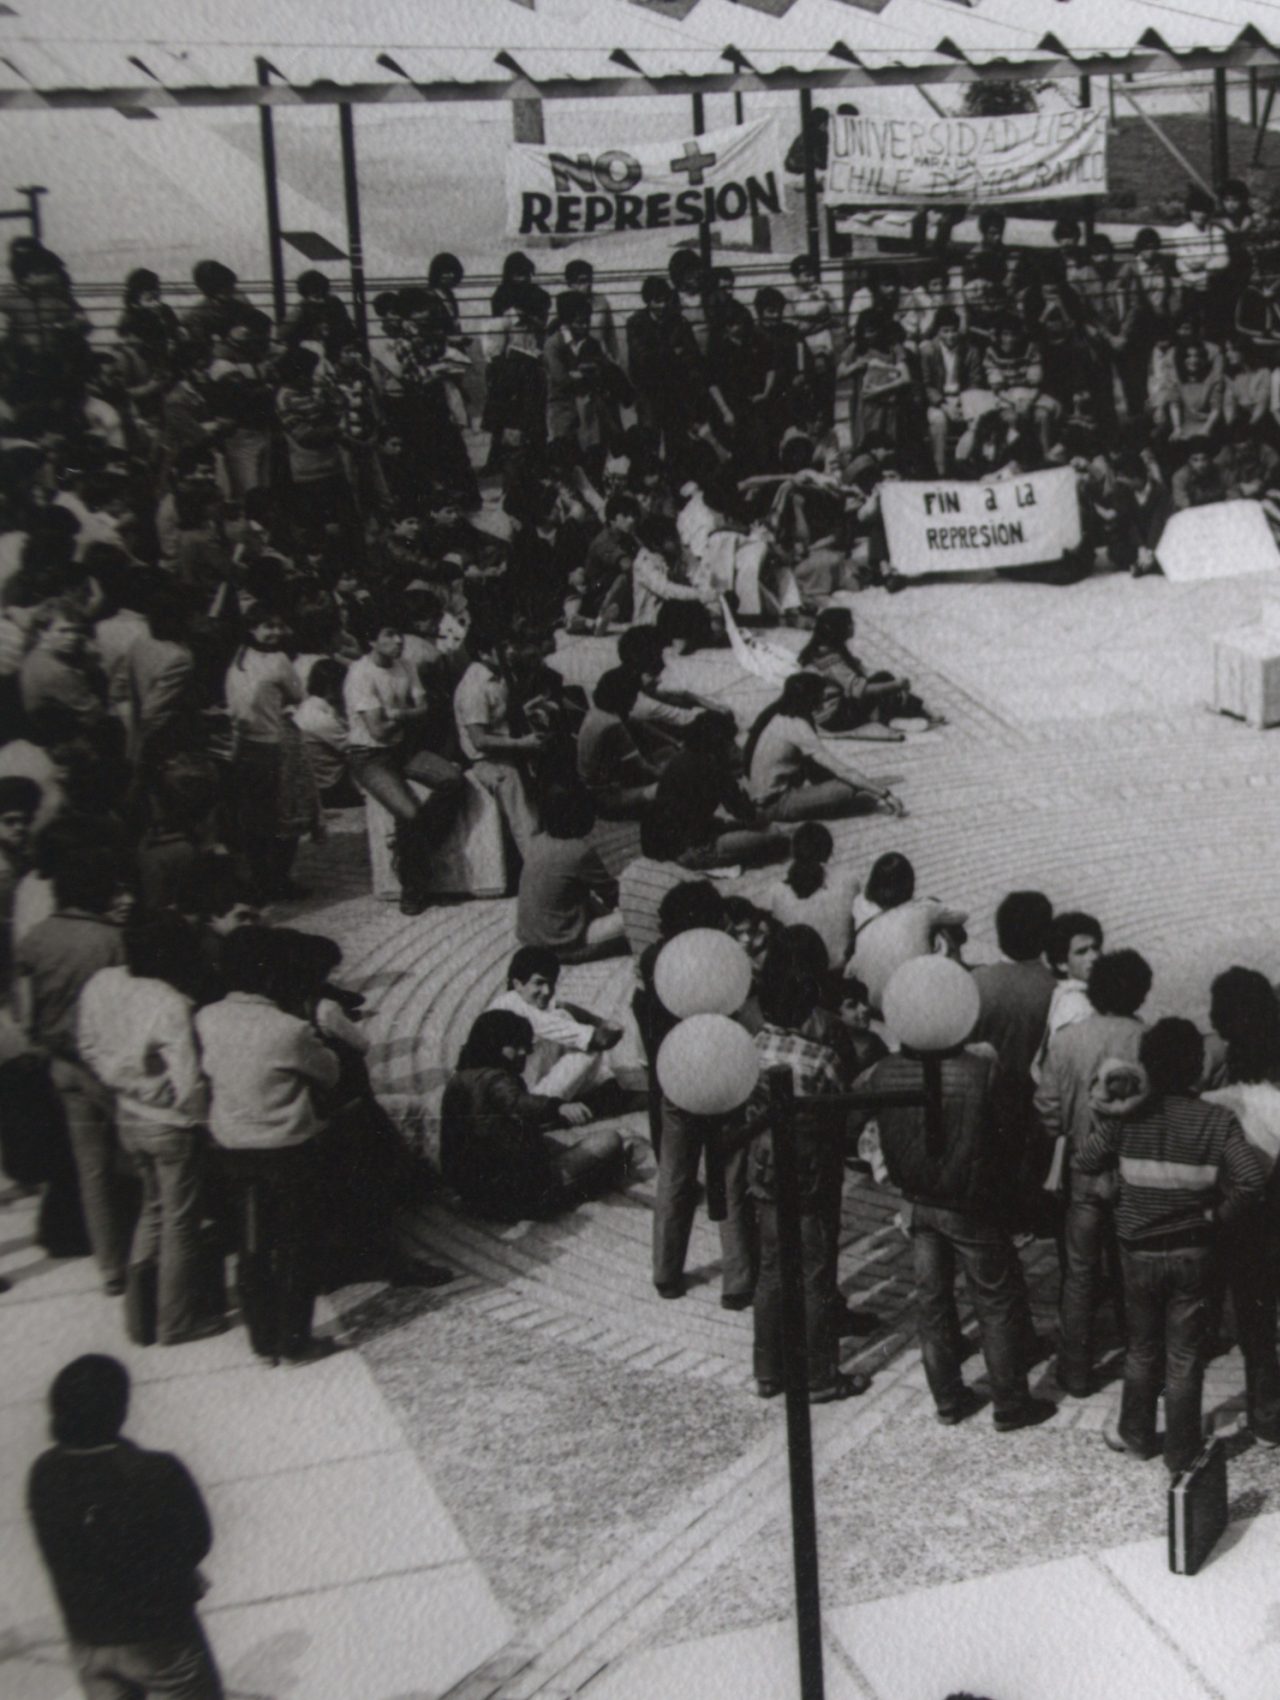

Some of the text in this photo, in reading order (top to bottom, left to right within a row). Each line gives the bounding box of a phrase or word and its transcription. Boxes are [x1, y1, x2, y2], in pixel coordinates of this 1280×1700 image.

[831, 114, 1020, 160] UNIVERSIDAD
[548, 141, 716, 193] NO +
[829, 160, 914, 197] CHILE
[519, 171, 782, 234] REPRESION
